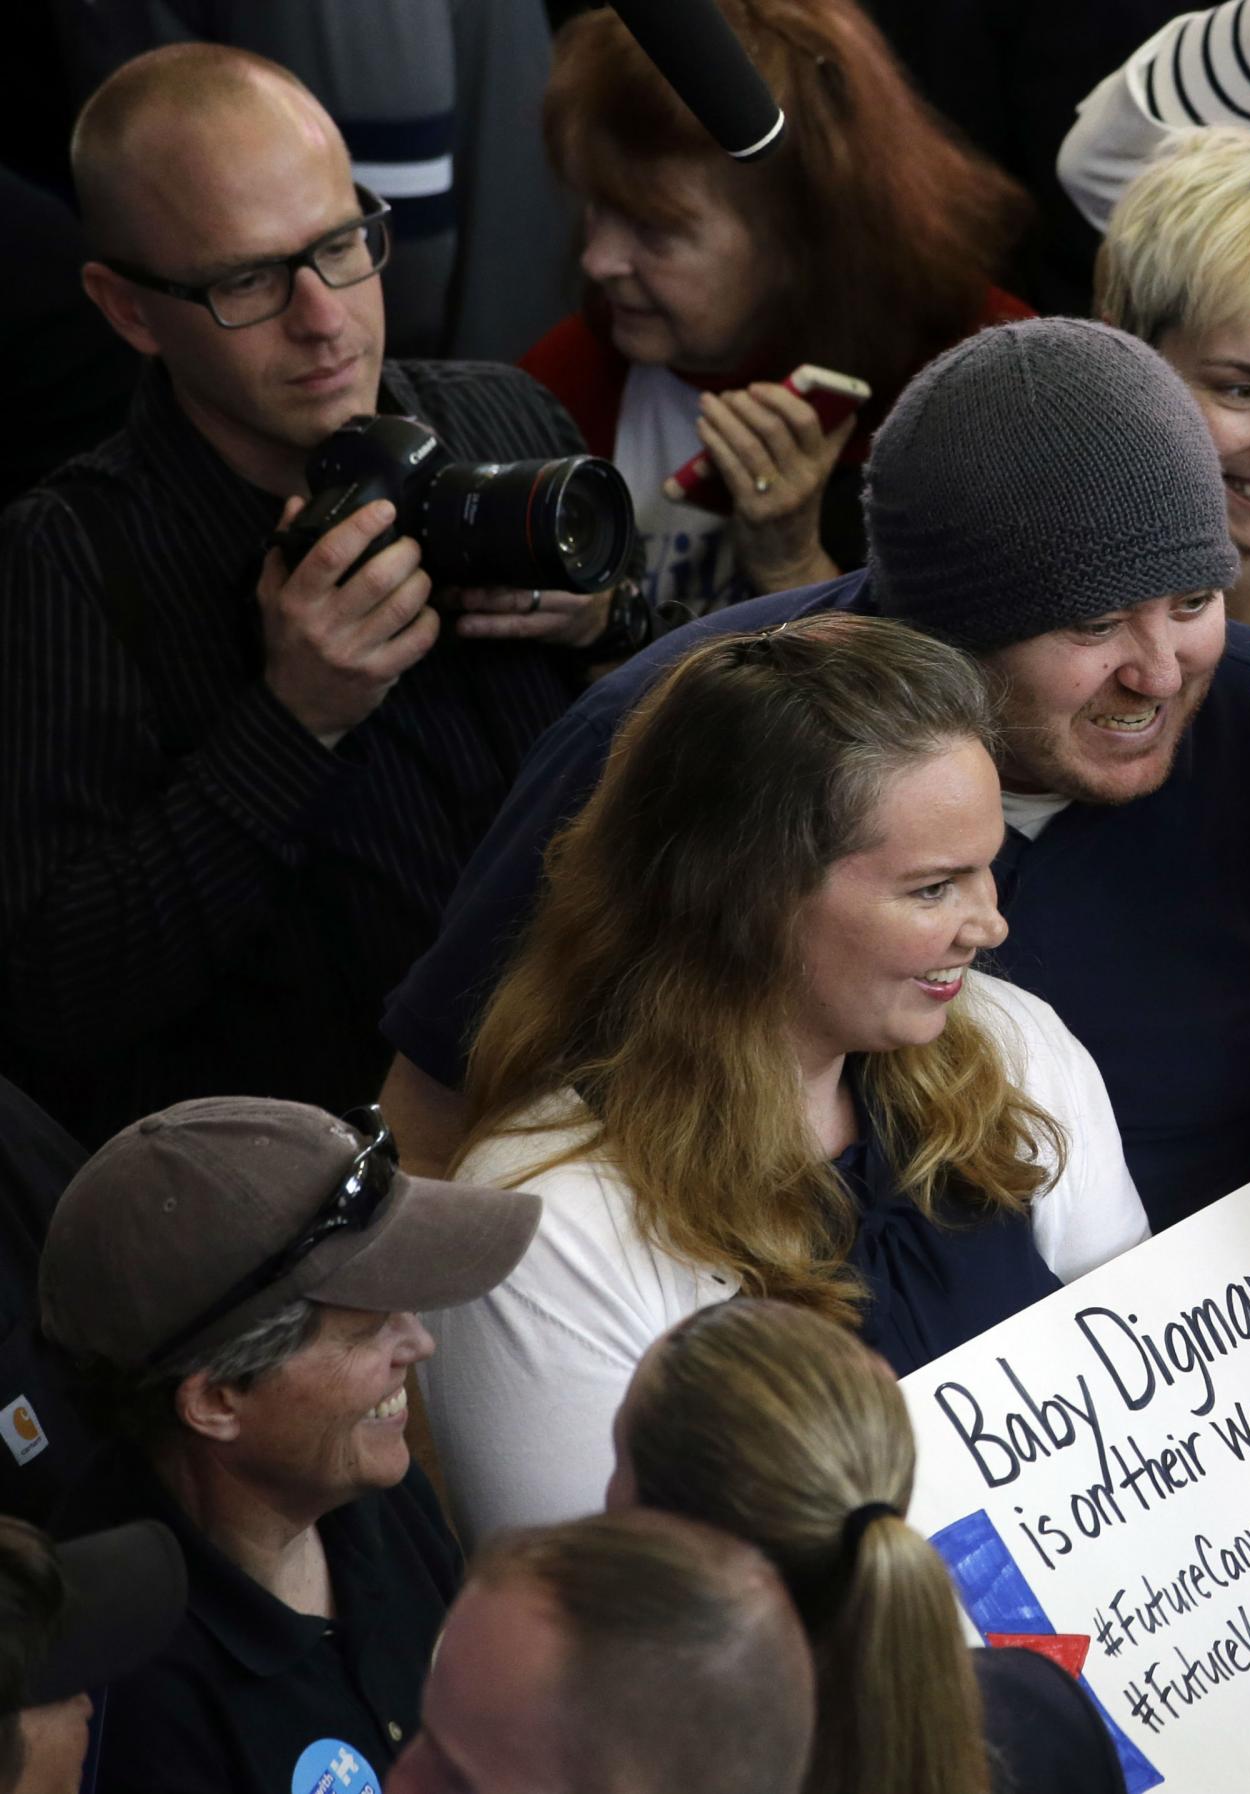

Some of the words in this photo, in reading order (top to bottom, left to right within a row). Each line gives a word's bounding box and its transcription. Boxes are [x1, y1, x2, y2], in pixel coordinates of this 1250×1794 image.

[934, 1356, 1114, 1493] Baby
[1014, 1506, 1073, 1570] is
[1071, 1483, 1127, 1538] on
[1110, 1431, 1207, 1510] their
